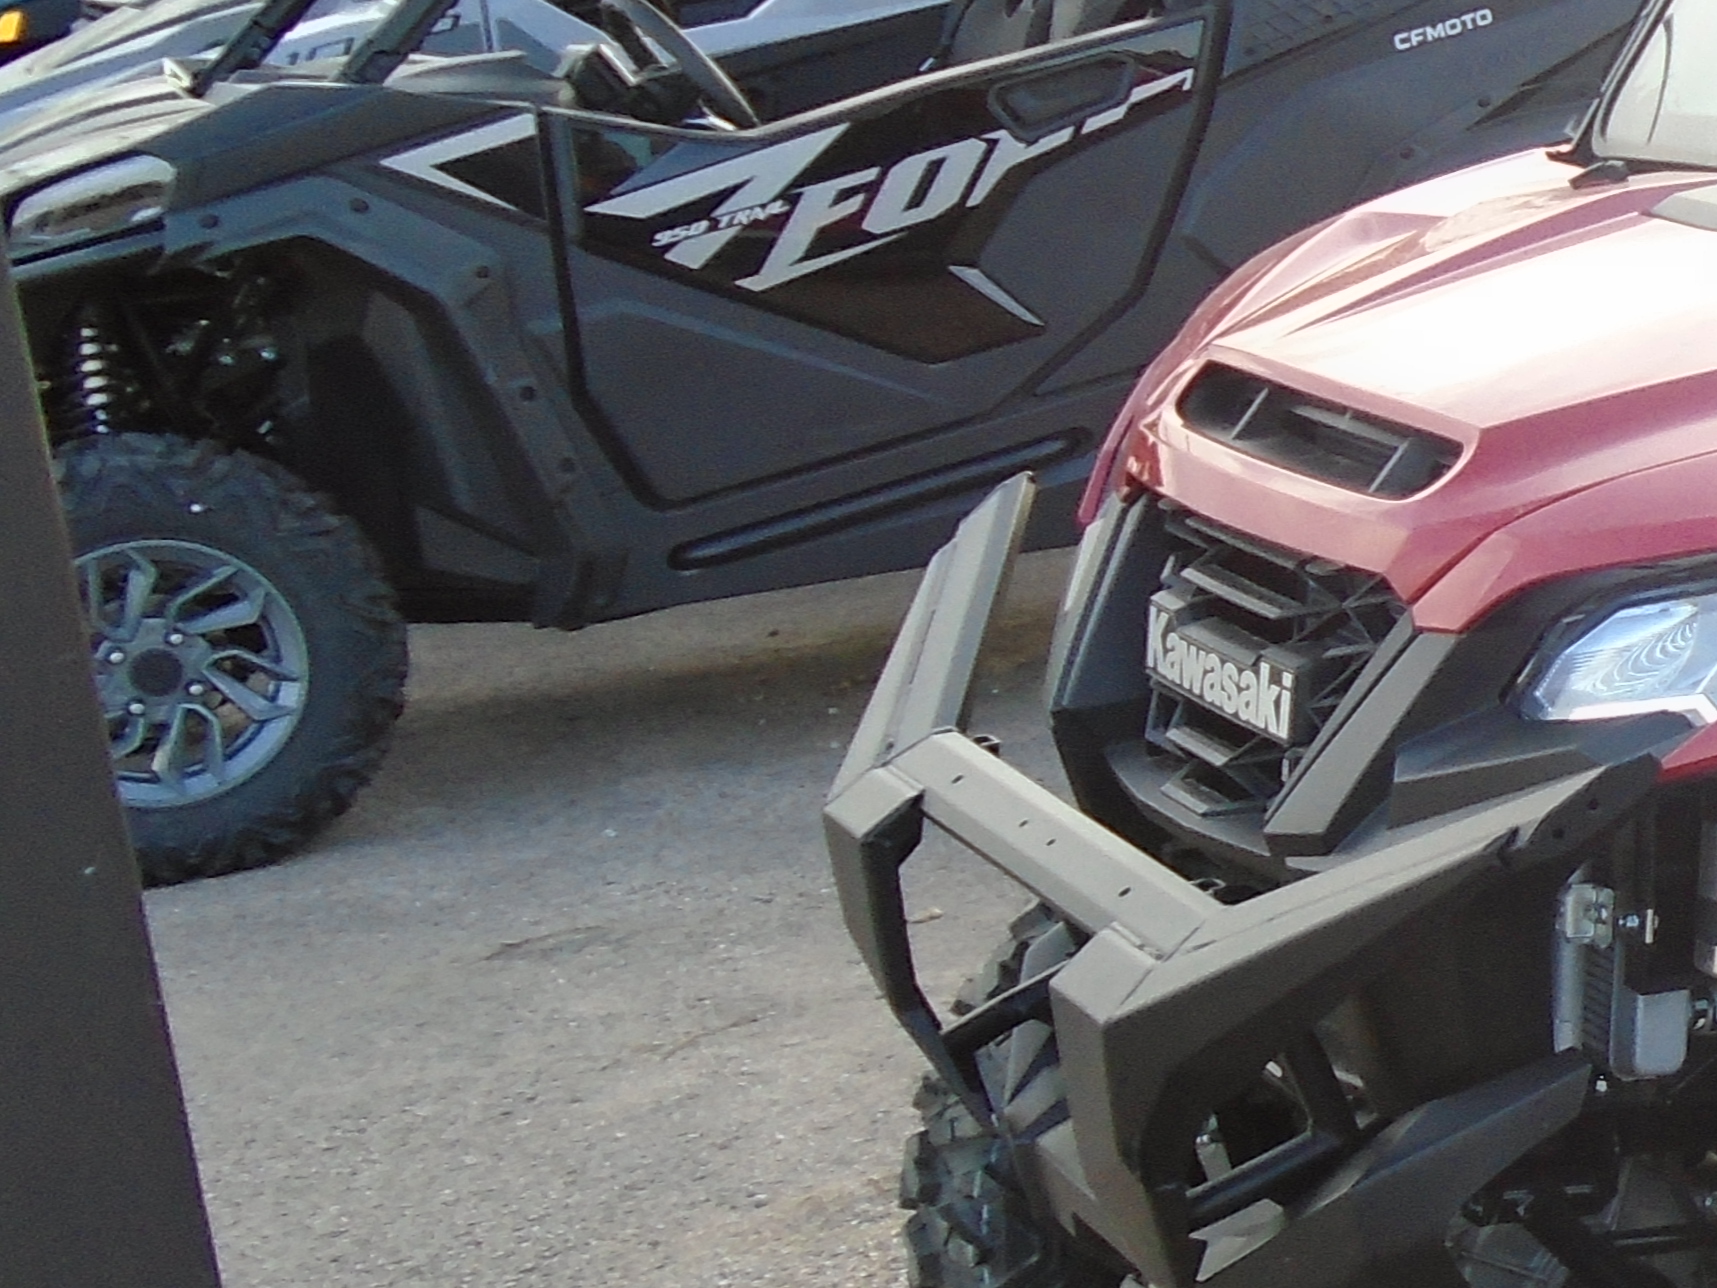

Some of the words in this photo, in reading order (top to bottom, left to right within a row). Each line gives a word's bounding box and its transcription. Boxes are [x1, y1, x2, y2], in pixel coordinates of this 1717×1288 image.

[1394, 8, 1493, 51] CFMOTO
[651, 219, 711, 247] 950
[716, 199, 792, 229] TRAIL
[1147, 604, 1293, 740] Kawasaki
